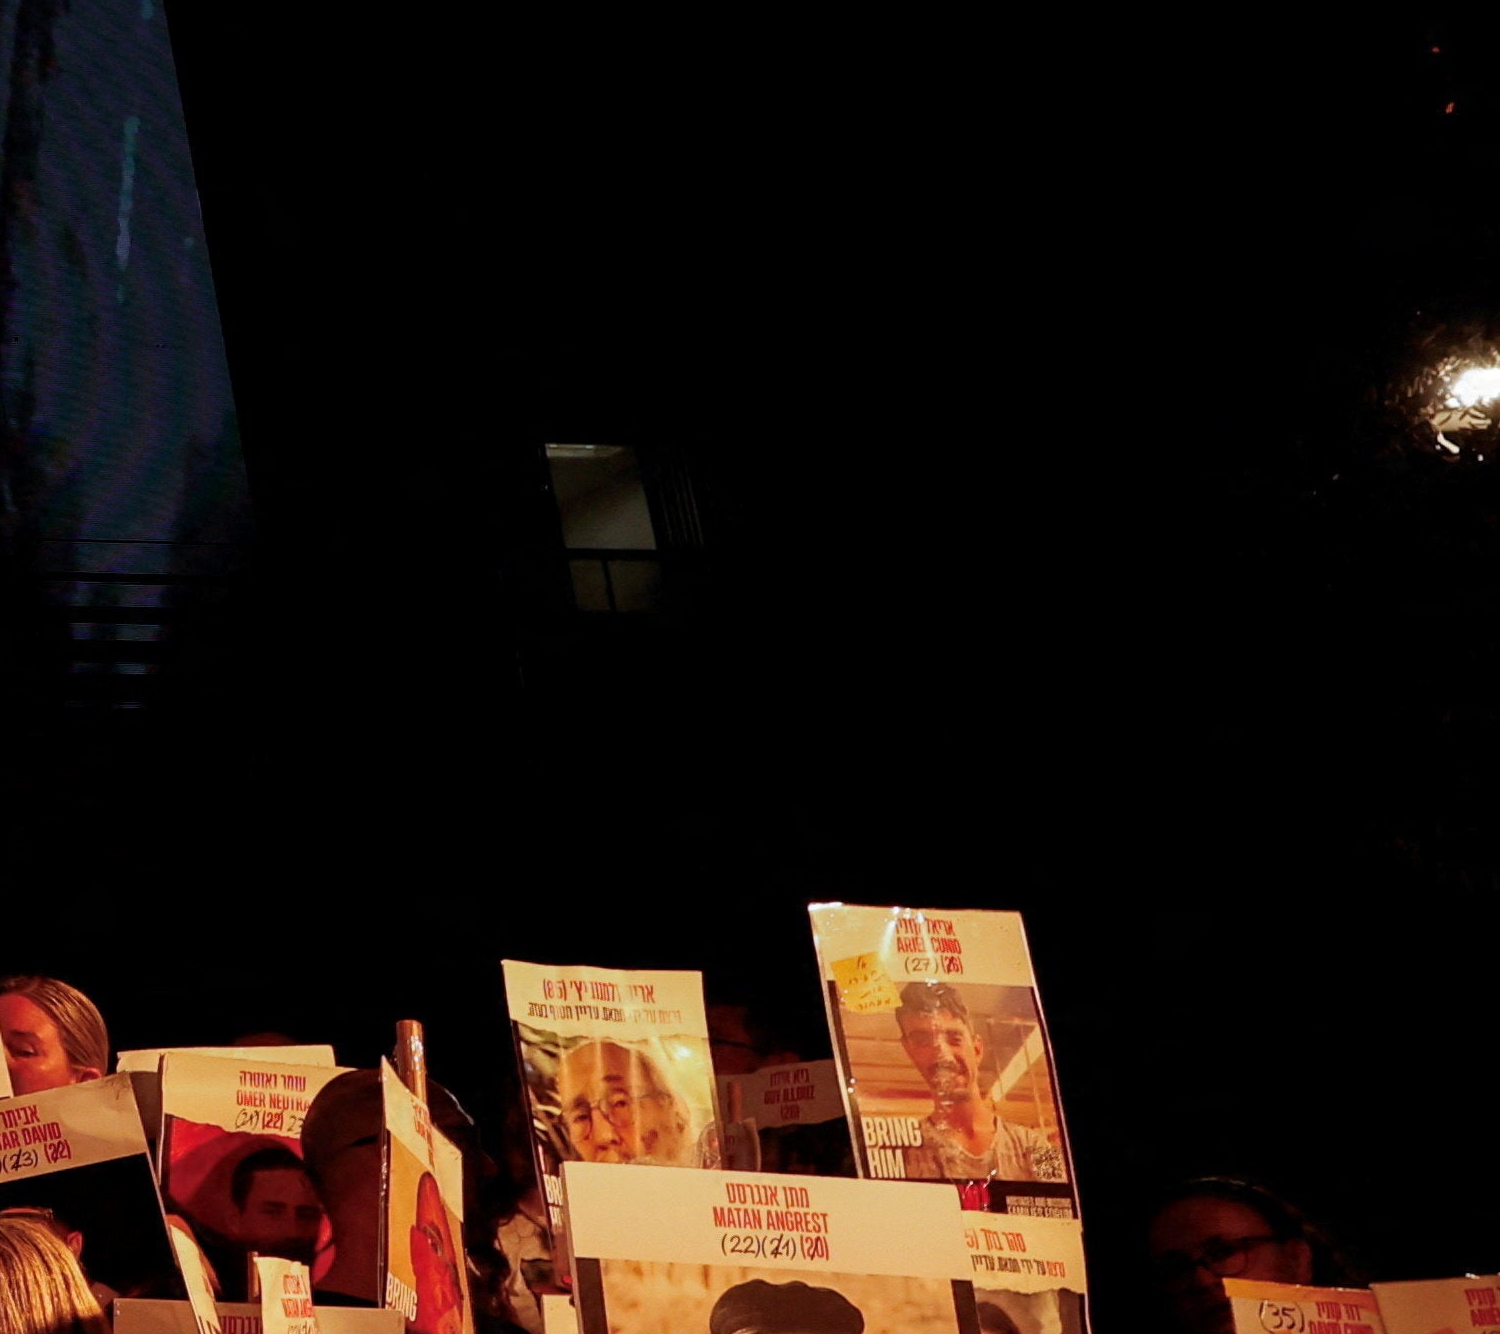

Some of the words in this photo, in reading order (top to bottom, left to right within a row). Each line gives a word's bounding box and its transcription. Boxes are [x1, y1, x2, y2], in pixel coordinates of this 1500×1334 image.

[236, 1090, 265, 1107] OMER
[22, 1122, 61, 1147] DAVID
[864, 1117, 921, 1147] BRING
[867, 1150, 905, 1178] HIM
[726, 1183, 780, 1216] אנגרסט
[712, 1207, 762, 1229] MATAN
[765, 1210, 828, 1234] ANGREST
